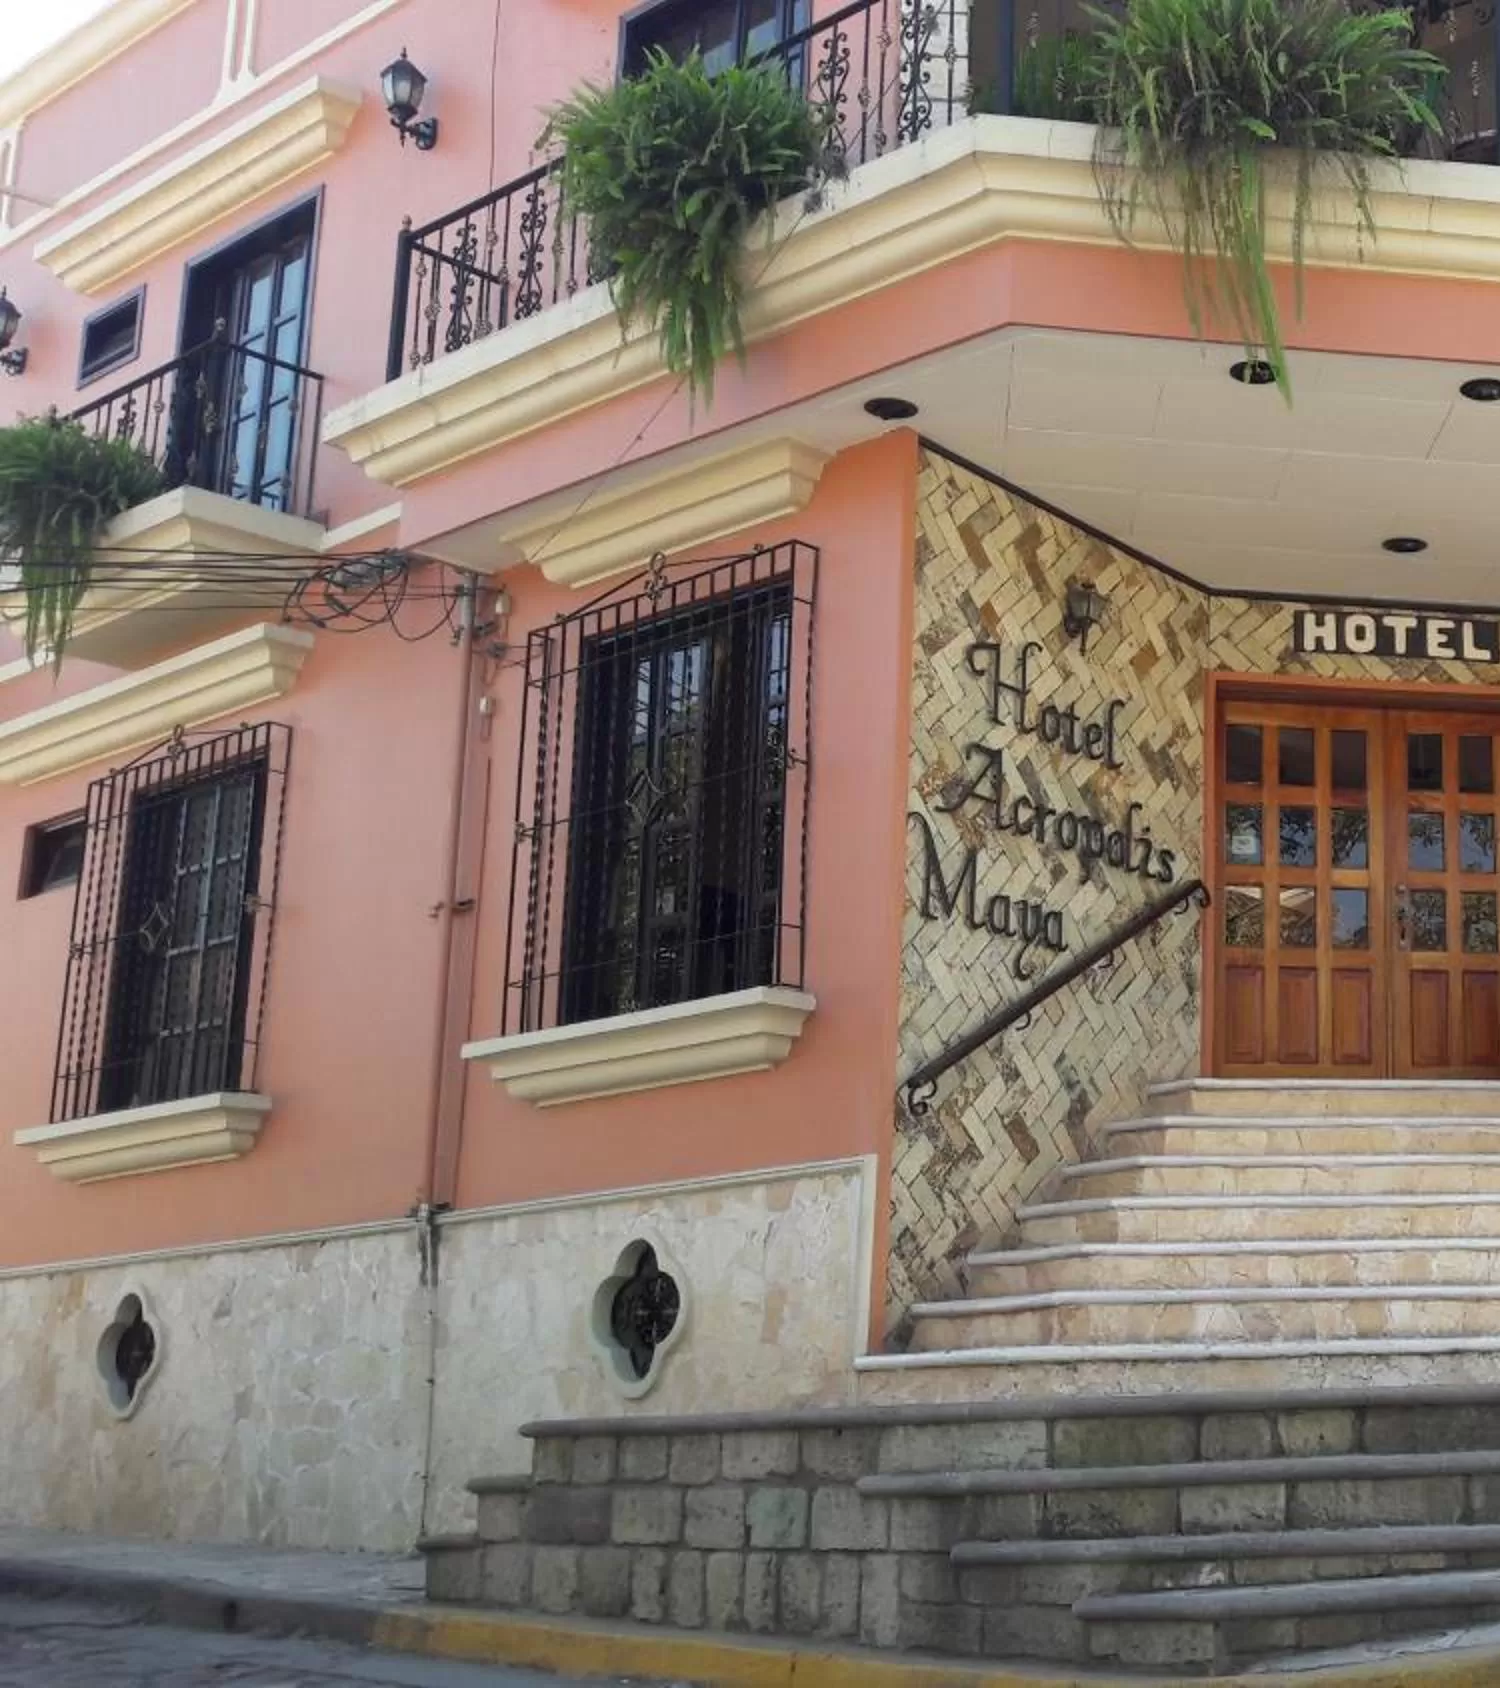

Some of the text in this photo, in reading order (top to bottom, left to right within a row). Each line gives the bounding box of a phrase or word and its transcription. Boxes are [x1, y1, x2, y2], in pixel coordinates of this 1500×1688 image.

[1302, 612, 1492, 660] HOTEL
[965, 641, 1125, 770] Hotel
[935, 743, 1176, 885] Acropolis
[907, 811, 1068, 979] Maya
